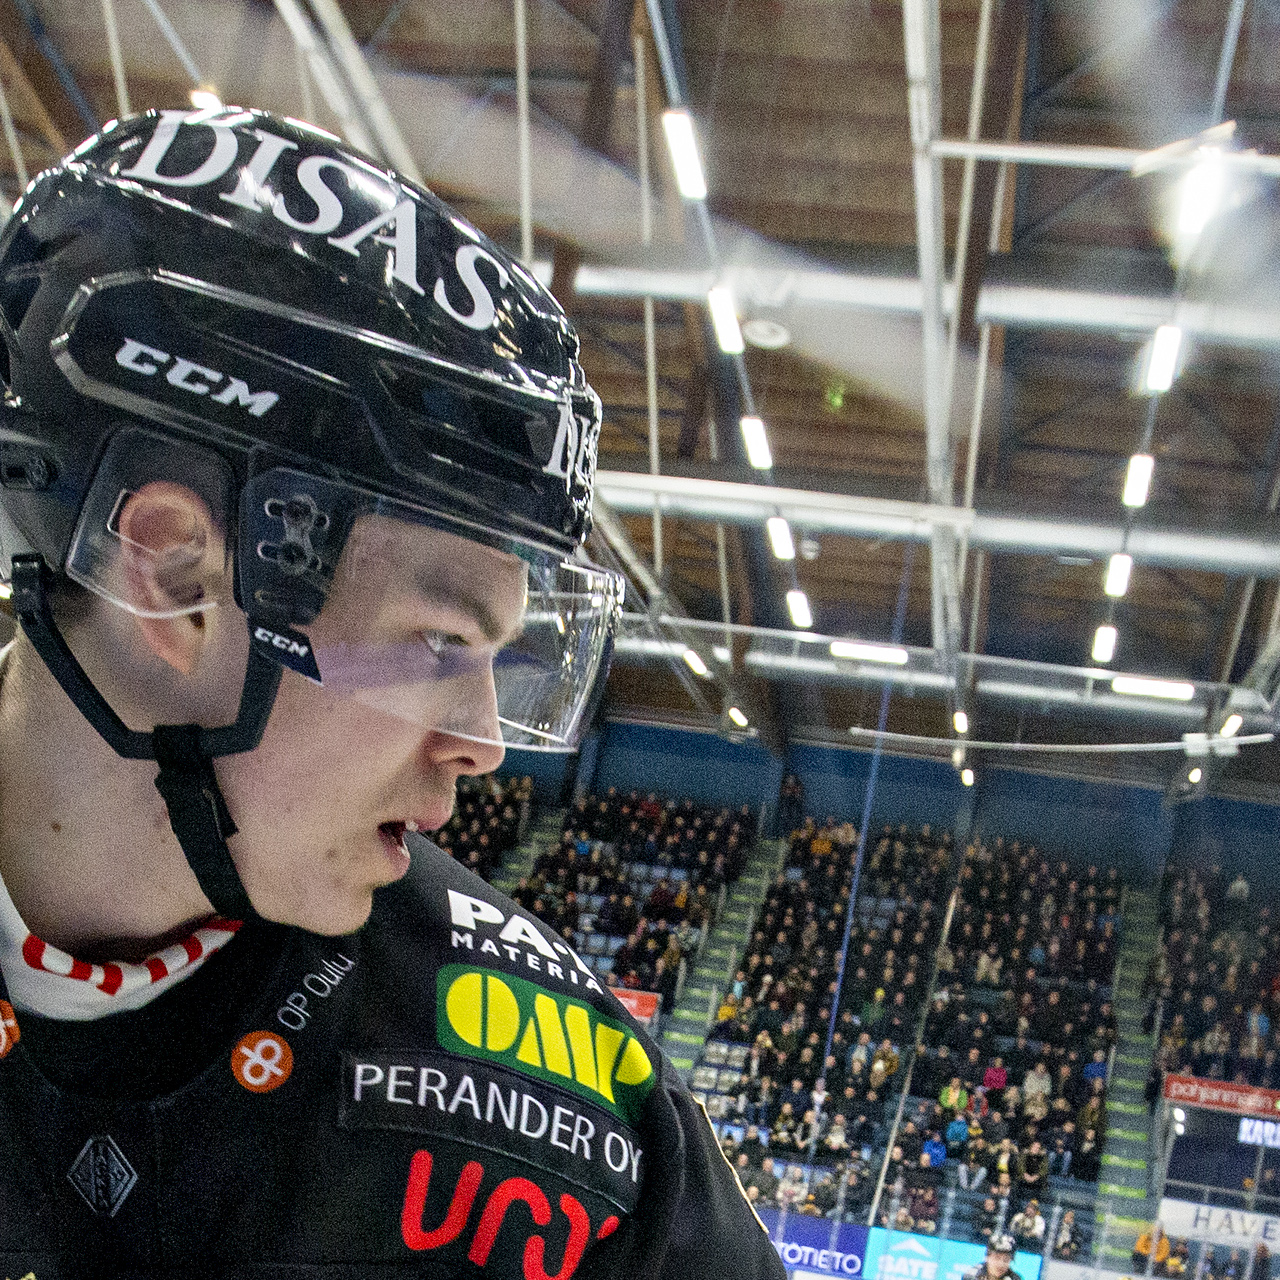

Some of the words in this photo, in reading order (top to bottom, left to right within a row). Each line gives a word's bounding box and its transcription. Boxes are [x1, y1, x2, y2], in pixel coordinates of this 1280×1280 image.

[121, 109, 511, 331] DISAS
[116, 338, 280, 418] CCM
[254, 626, 309, 659] CCM
[277, 992, 312, 1032] OP
[303, 953, 357, 1000] Oulu
[451, 930, 605, 995] MATERIA
[353, 1063, 596, 1161] PERANDER
[603, 1131, 643, 1183] OY
